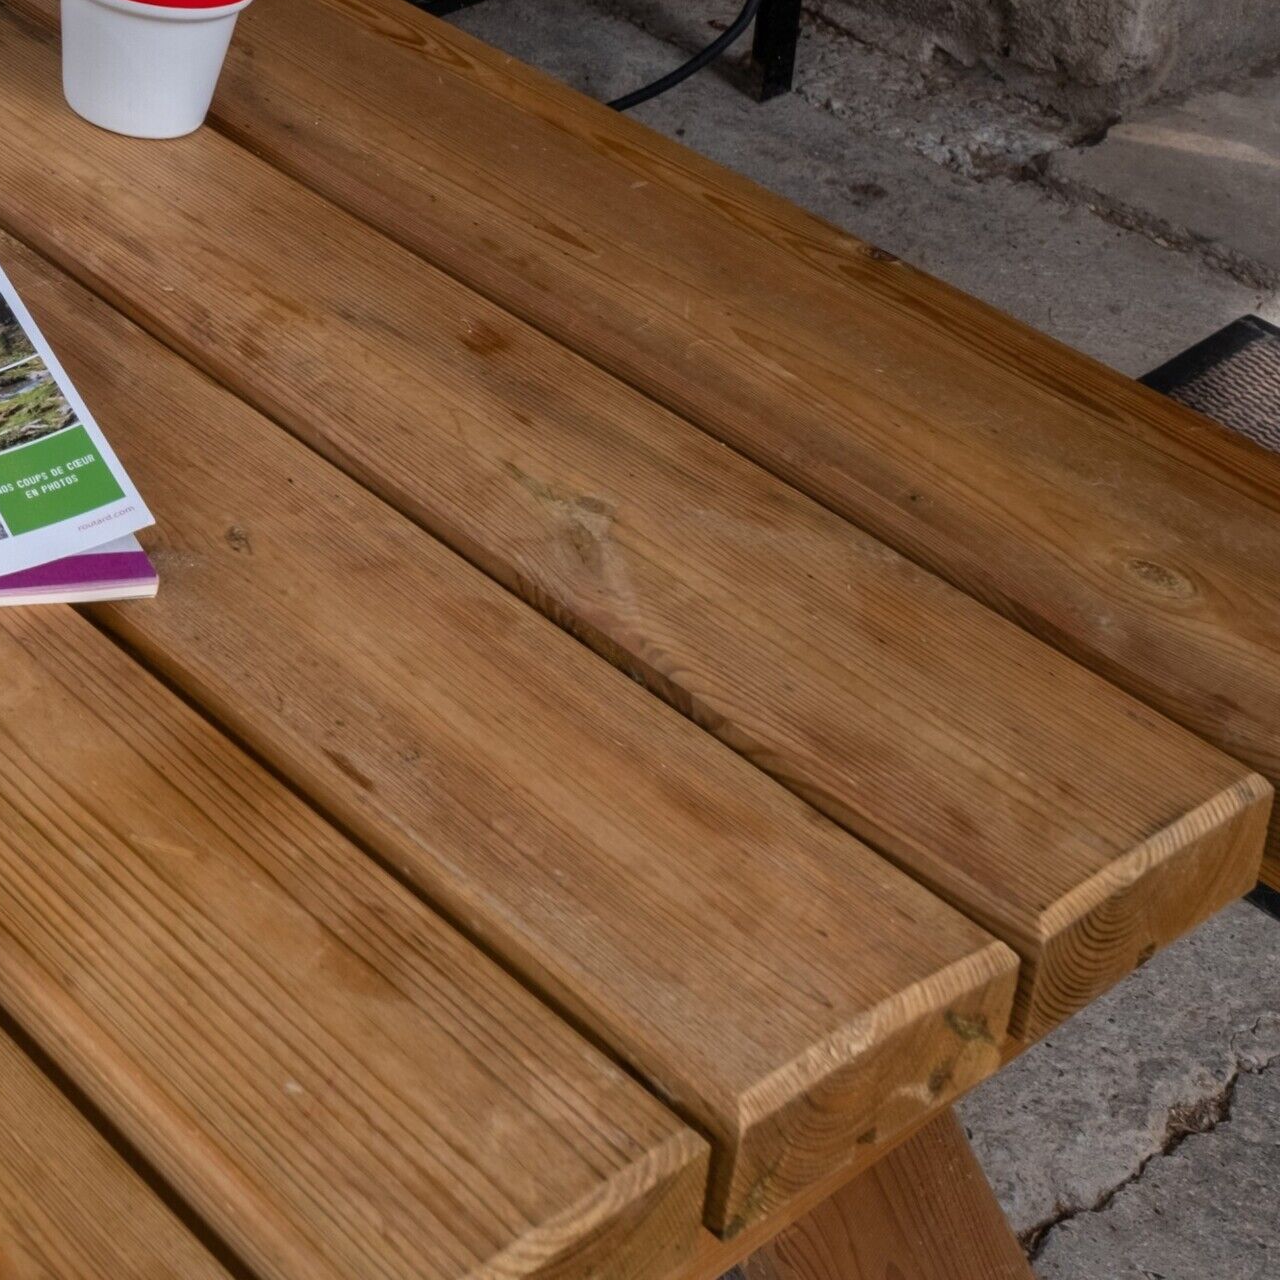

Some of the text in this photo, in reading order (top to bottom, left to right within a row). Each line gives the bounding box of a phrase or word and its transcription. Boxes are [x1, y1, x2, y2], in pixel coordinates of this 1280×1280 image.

[16, 472, 49, 489] COUPS
[50, 465, 64, 478] DE
[25, 475, 79, 500] EN PHOTOS
[78, 505, 135, 531] routard.com
